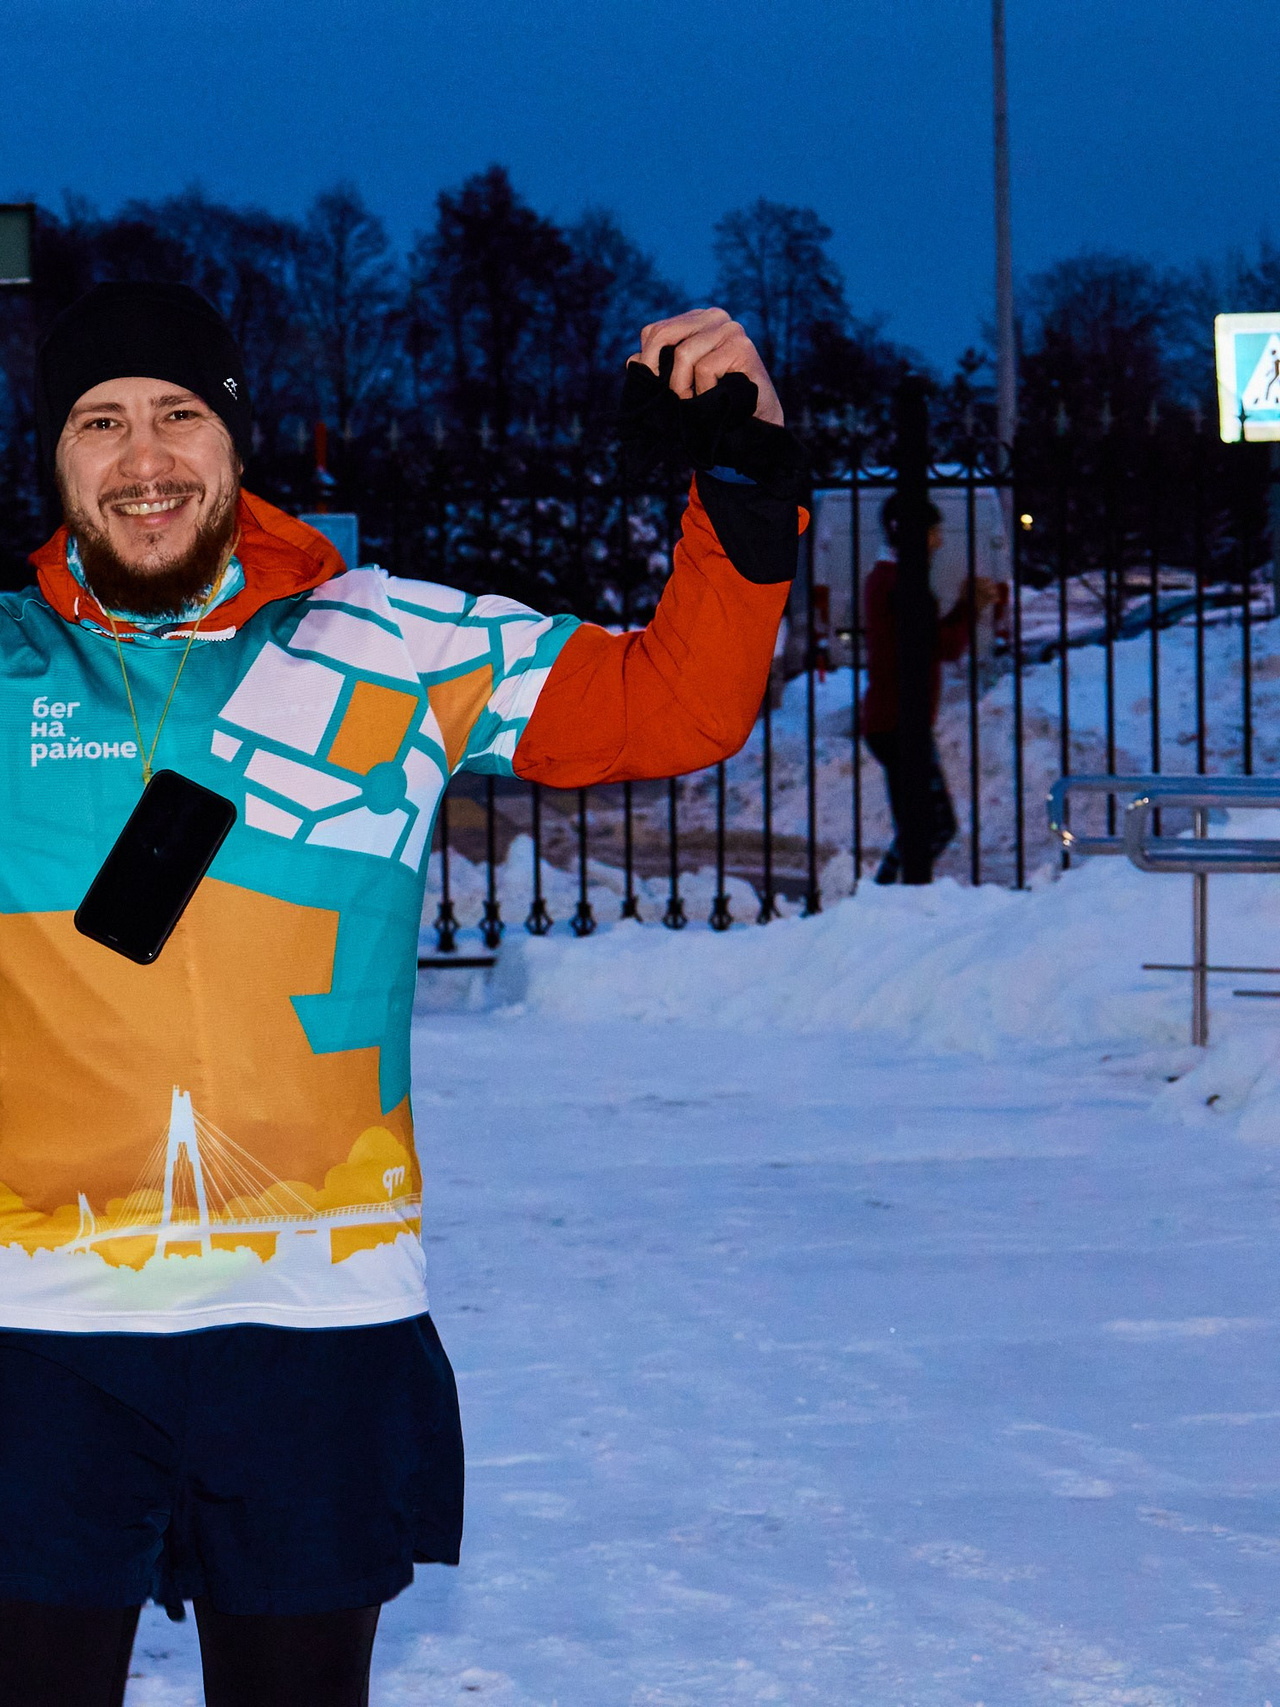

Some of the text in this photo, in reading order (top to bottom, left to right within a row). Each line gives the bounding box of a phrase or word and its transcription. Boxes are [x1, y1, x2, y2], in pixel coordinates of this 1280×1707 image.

[32, 696, 81, 719] бег
[31, 720, 66, 738] на
[31, 736, 138, 767] районе
